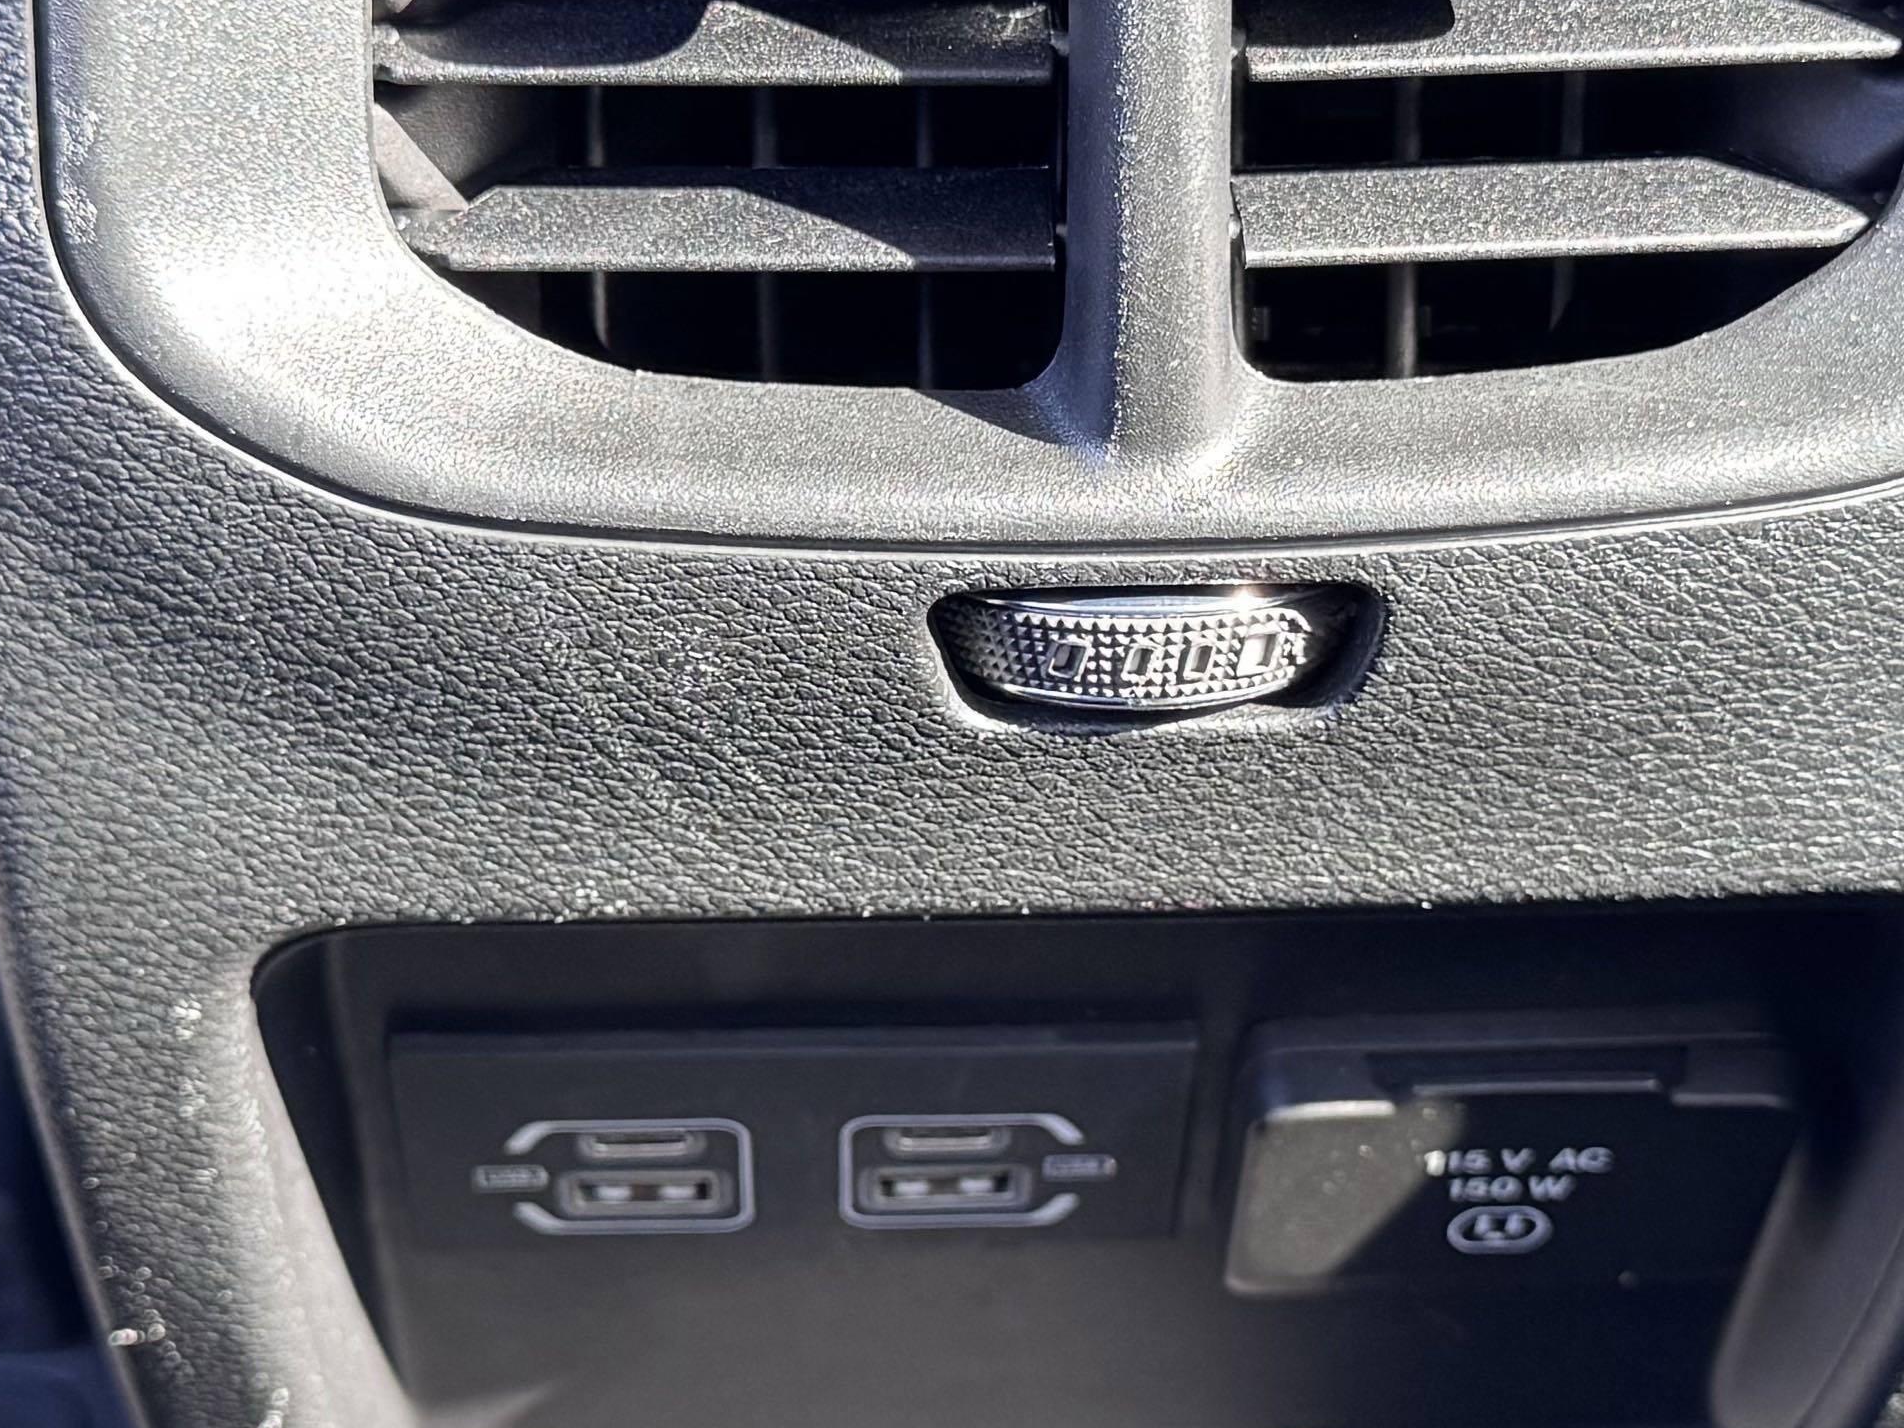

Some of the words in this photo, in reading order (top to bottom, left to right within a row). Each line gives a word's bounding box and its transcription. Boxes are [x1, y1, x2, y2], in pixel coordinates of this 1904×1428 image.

[1424, 1148, 1493, 1176] 115
[1500, 1148, 1536, 1172] V
[1548, 1146, 1614, 1174] AC
[1449, 1176, 1524, 1202] 150
[1527, 1175, 1578, 1202] W
